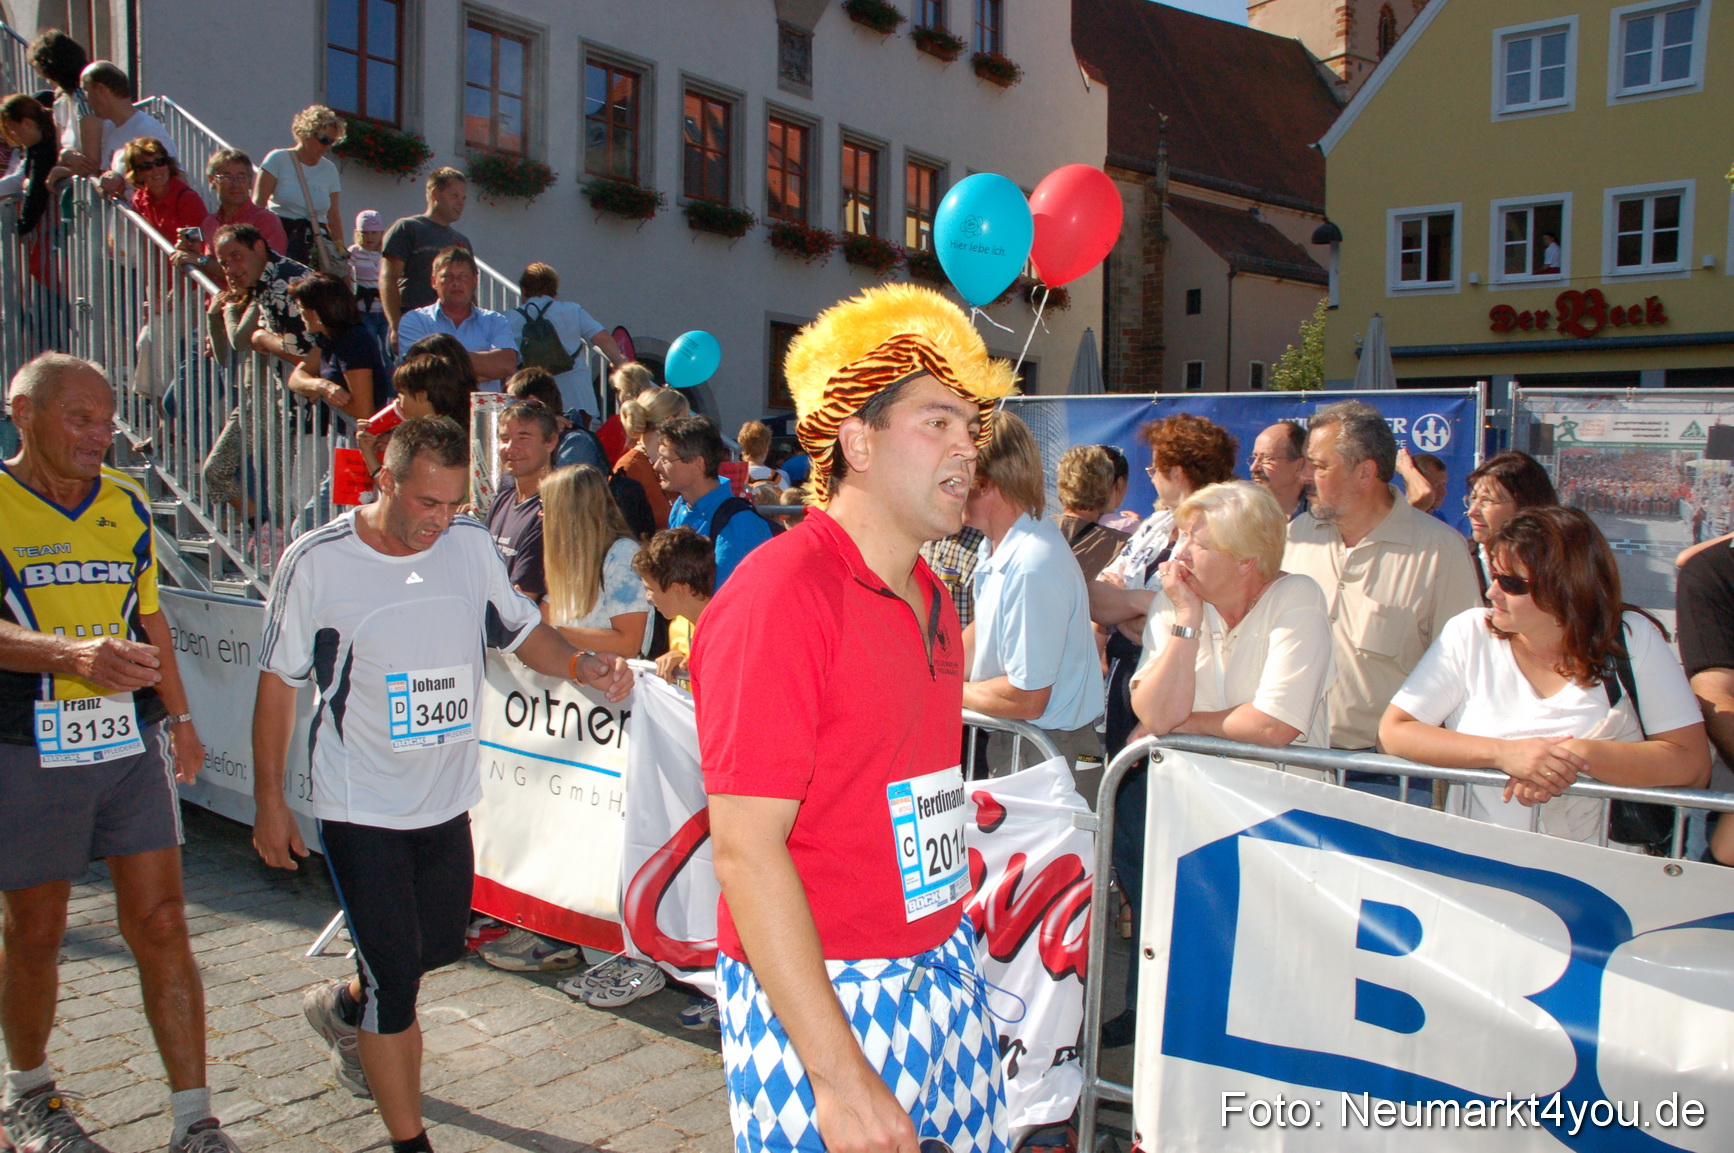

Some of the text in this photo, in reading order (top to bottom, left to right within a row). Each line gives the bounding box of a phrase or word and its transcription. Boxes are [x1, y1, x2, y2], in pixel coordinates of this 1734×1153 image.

[949, 240, 1007, 257] Hier lebe ich.
[1489, 288, 1668, 338] Der Beck
[13, 543, 72, 557] TEAM
[21, 560, 135, 588] BOCK
[218, 629, 250, 667] ein
[412, 677, 455, 693] Johann
[63, 697, 102, 712] Franz
[395, 701, 406, 714] D
[416, 697, 468, 727] 3400
[42, 719, 54, 732] D
[66, 715, 131, 744] 3133
[505, 689, 631, 749] ortner
[202, 744, 247, 780] elefon:
[549, 774, 624, 813] GmbH
[903, 836, 915, 857] C
[926, 825, 966, 877] 2014
[907, 889, 941, 913] BOCK
